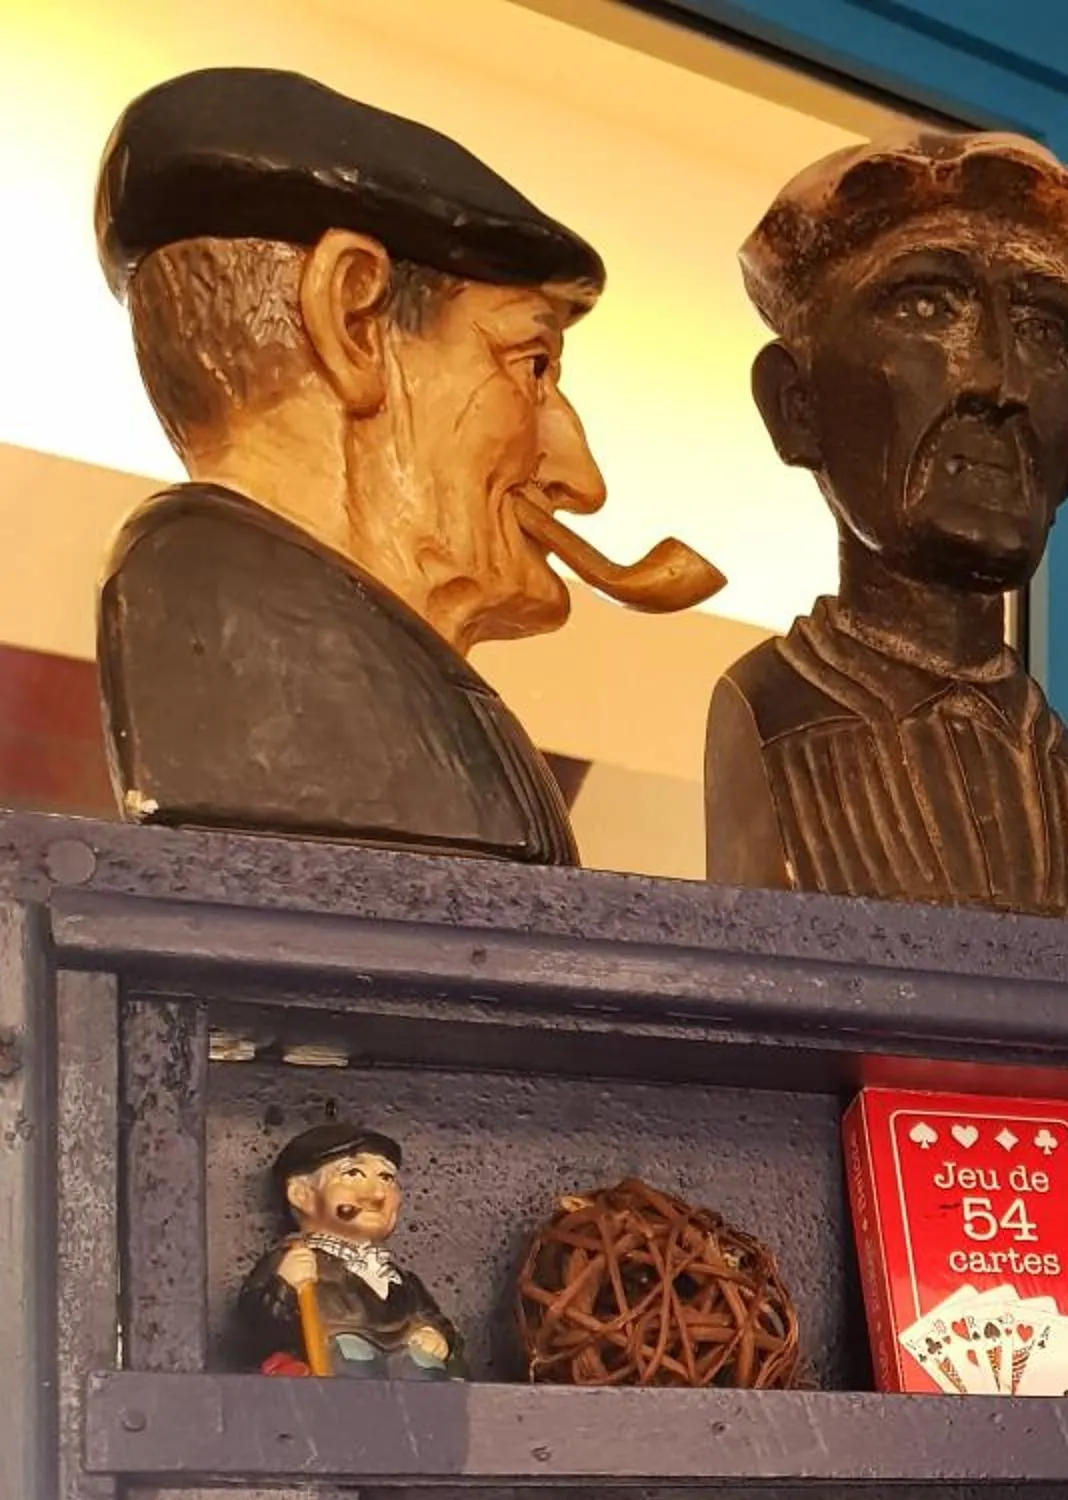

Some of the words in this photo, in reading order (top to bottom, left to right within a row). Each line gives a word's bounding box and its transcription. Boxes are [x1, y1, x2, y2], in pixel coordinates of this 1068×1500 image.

[933, 1161, 1001, 1190] Jeu
[1009, 1165, 1049, 1193] de
[962, 1196, 1038, 1241] 54
[949, 1247, 1061, 1276] cartes
